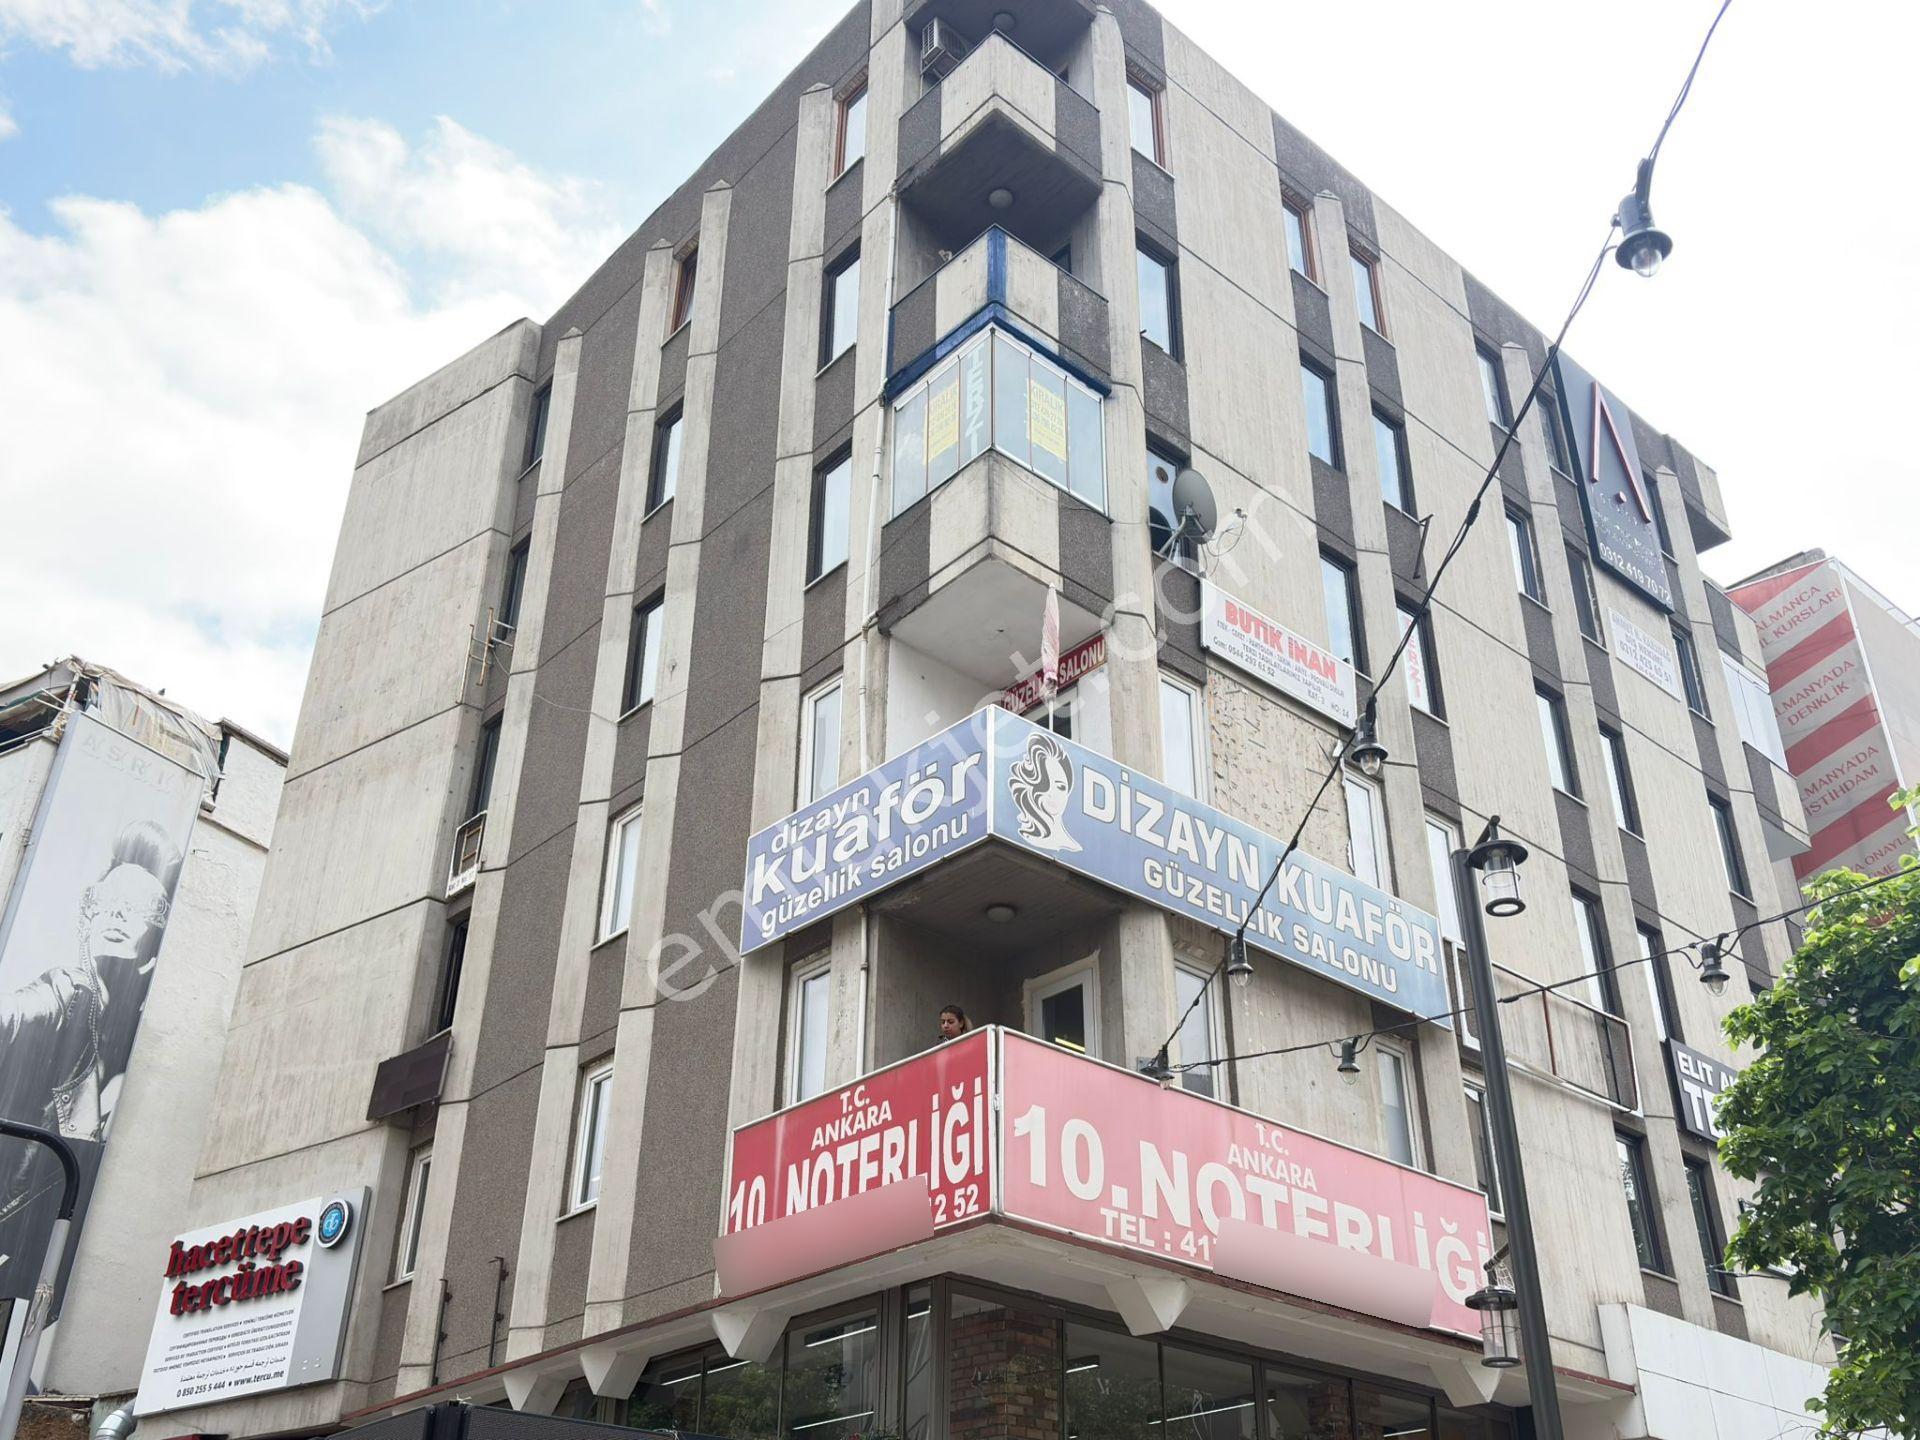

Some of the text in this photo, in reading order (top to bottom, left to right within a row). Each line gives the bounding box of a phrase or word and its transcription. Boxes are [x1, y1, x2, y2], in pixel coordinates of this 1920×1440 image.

[1756, 585, 1821, 632] ALMANCA
[1773, 587, 1842, 639] KURSLARI
[1059, 640, 1105, 685] SALONU
[1800, 745, 1879, 800] MANYA'DA
[751, 752, 982, 906] kuaför
[771, 786, 870, 854] dizayn
[762, 811, 968, 939] güzellik salonu
[1082, 765, 1438, 976] DİZAYN KUAFÖR
[1143, 858, 1397, 994] GÜZELLİK SALONU
[840, 1084, 870, 1112] T.C.
[811, 1100, 892, 1151] ANKARA
[1255, 1122, 1290, 1156] T.C.
[1228, 1143, 1317, 1193] ANKARA
[953, 1183, 979, 1218] 52
[164, 1216, 312, 1278] hacettepe
[1100, 1207, 1155, 1248] TEL
[1181, 1230, 1217, 1261] 41
[170, 1259, 304, 1317] tercüme
[182, 1386, 194, 1397] 850
[195, 1384, 207, 1395] 255
[214, 1380, 226, 1390] 444
[233, 1370, 285, 1387] www.tercu.me
